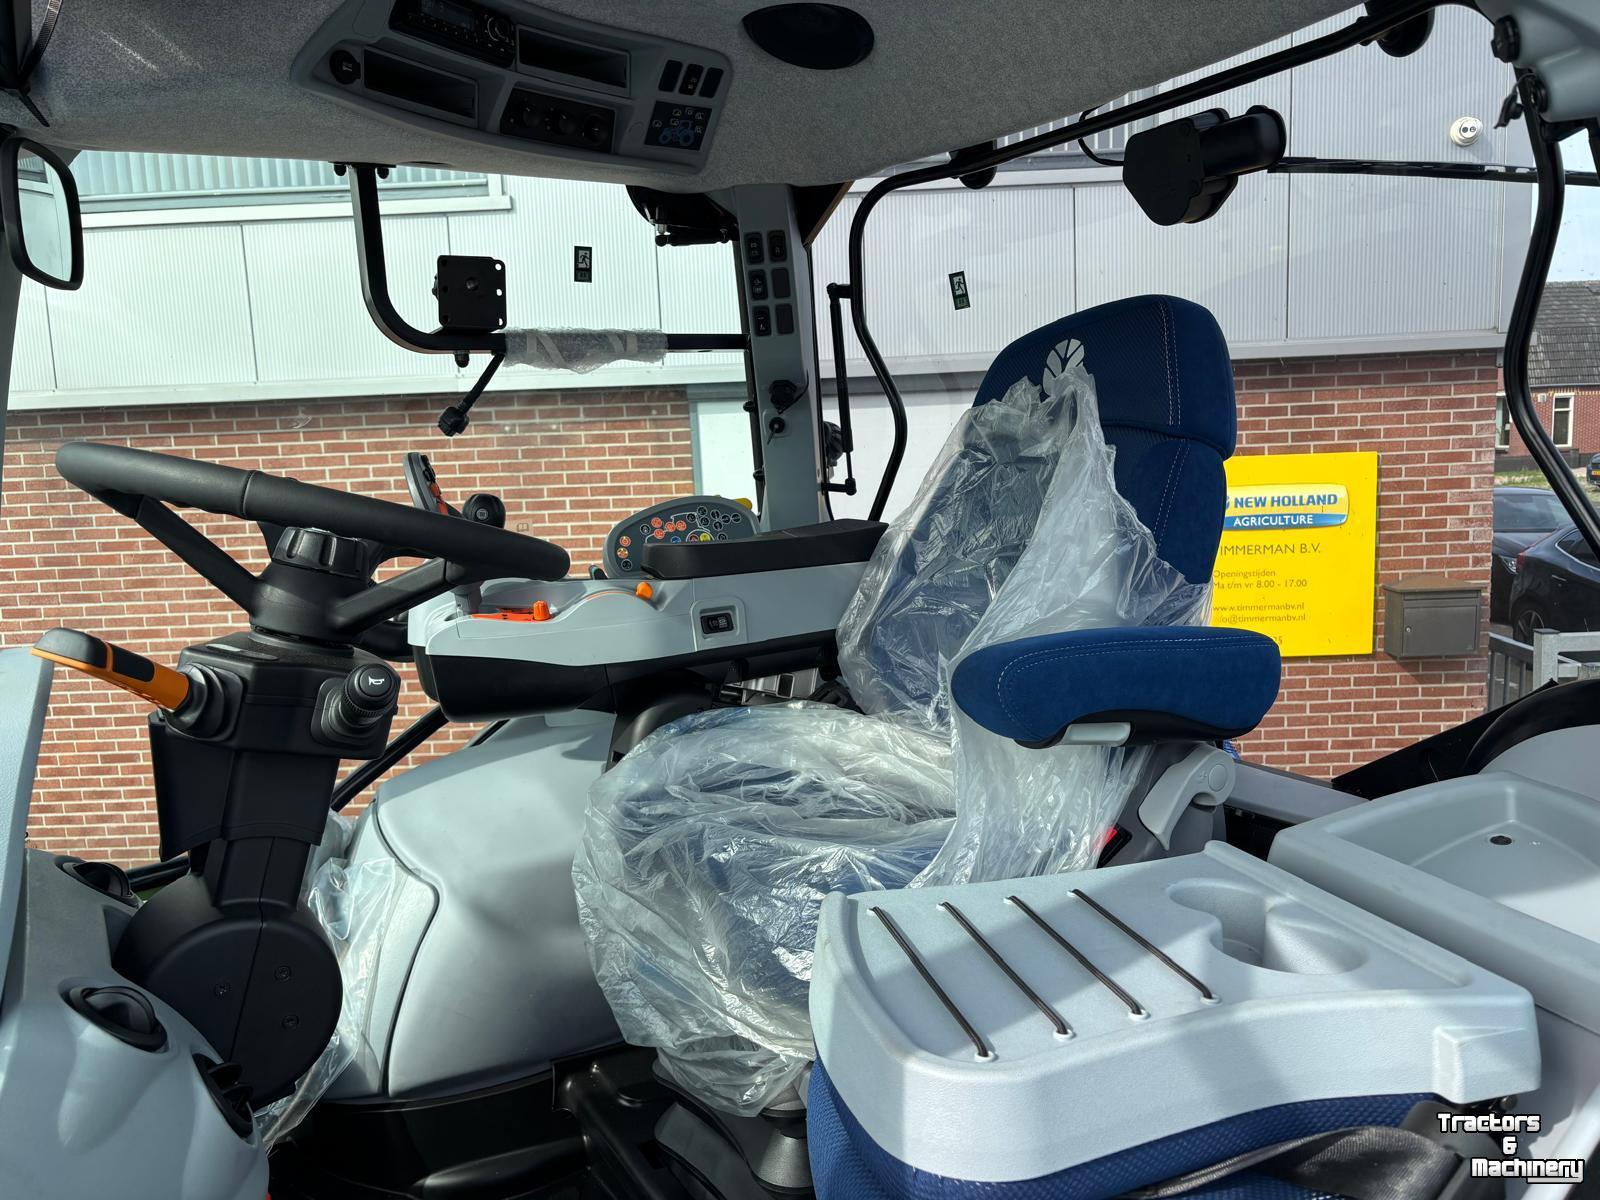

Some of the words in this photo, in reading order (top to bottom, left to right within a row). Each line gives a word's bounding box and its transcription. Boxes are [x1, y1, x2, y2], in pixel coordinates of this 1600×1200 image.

[1234, 496, 1267, 508] NEW
[1271, 494, 1338, 507] HOLLAND
[1233, 515, 1313, 527] AGRICULTURE
[1219, 543, 1295, 556] IMMERMAN
[1300, 542, 1321, 554] B.V.
[1212, 569, 1276, 579] Openingstijden
[1227, 581, 1242, 589] t/m
[1256, 579, 1275, 588] 8.00
[1284, 579, 1308, 588] 17.00
